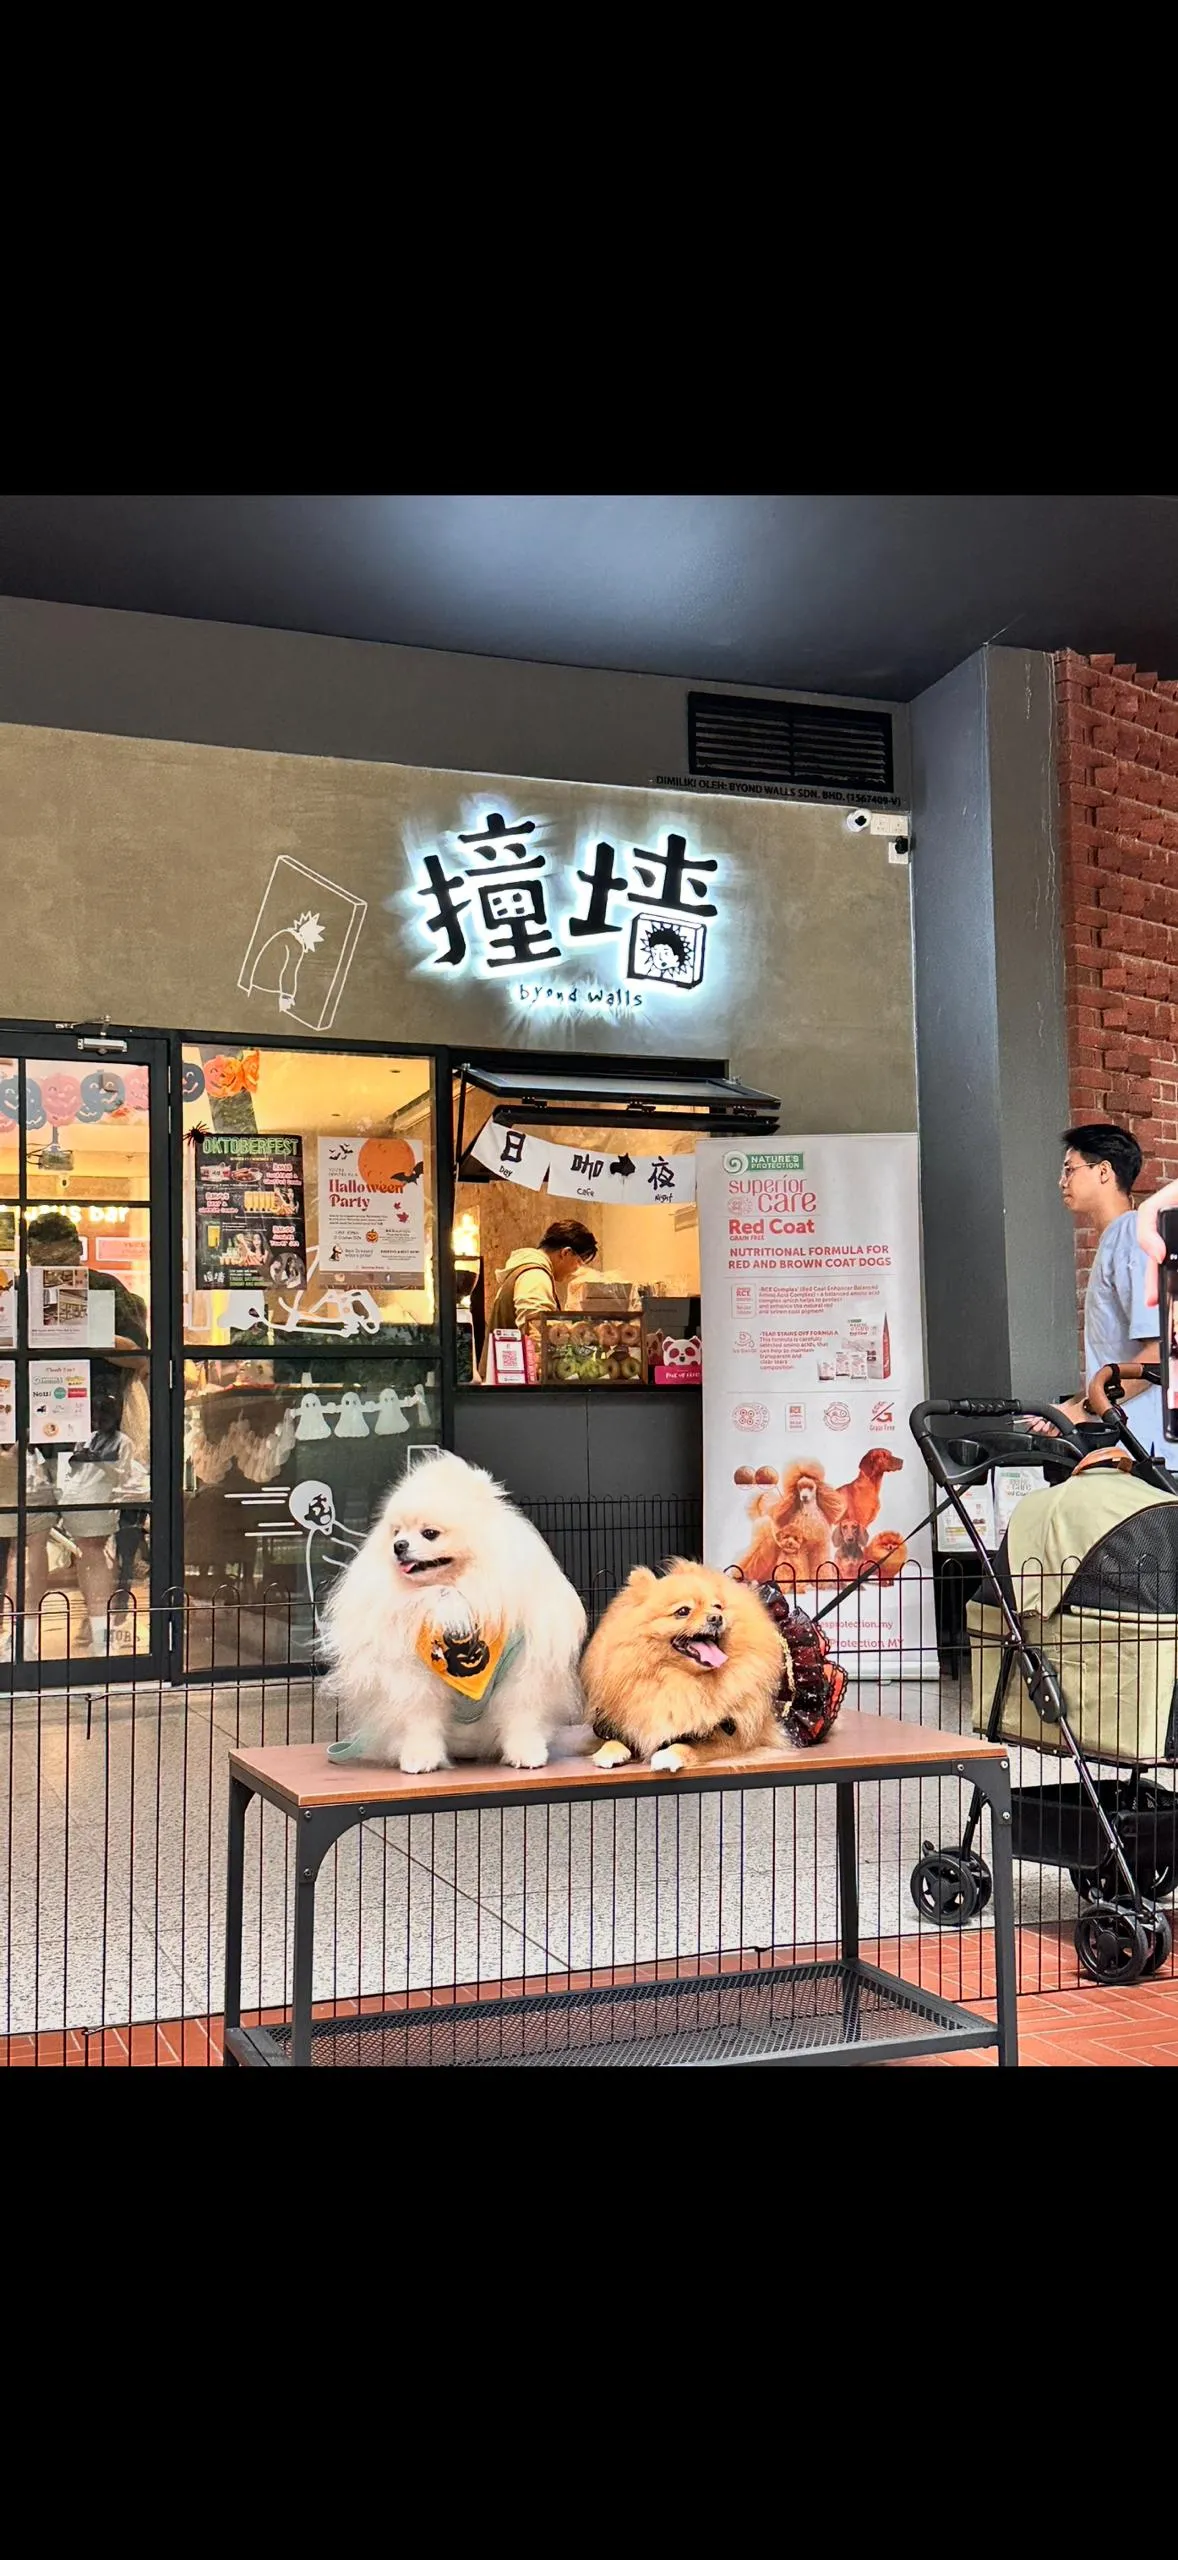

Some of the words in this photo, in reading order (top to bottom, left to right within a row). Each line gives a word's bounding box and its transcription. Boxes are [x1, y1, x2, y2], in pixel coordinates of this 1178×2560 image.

[656, 775, 697, 787] DIMILIKI
[698, 779, 728, 790] OLEH:
[728, 782, 763, 794] BYOND
[763, 785, 796, 797] WALLS
[797, 788, 821, 799] SDN.
[821, 791, 845, 801] BHD.
[417, 812, 718, 990] 撞墙
[519, 983, 578, 1006] byond
[587, 988, 643, 1007] walls
[202, 1136, 299, 1156] OKTOBERFEST
[499, 1130, 527, 1163] 日
[570, 1153, 605, 1181] 咖
[751, 1155, 800, 1163] NATURE'S
[647, 1155, 676, 1190] 夜
[329, 1178, 404, 1194] Halloween
[728, 1174, 808, 1196] superior
[328, 1193, 370, 1212] Party
[758, 1192, 817, 1213] care
[728, 1218, 765, 1235] Red
[769, 1218, 815, 1235] Coat
[730, 1247, 806, 1257] NUTRITIONAL
[808, 1245, 864, 1256] FORMULA
[866, 1244, 889, 1254] FOR
[728, 1260, 751, 1269] RED
[752, 1259, 777, 1269] AND
[779, 1259, 823, 1269] BROWN
[824, 1258, 856, 1268] COAT
[858, 1257, 892, 1267] DOGS
